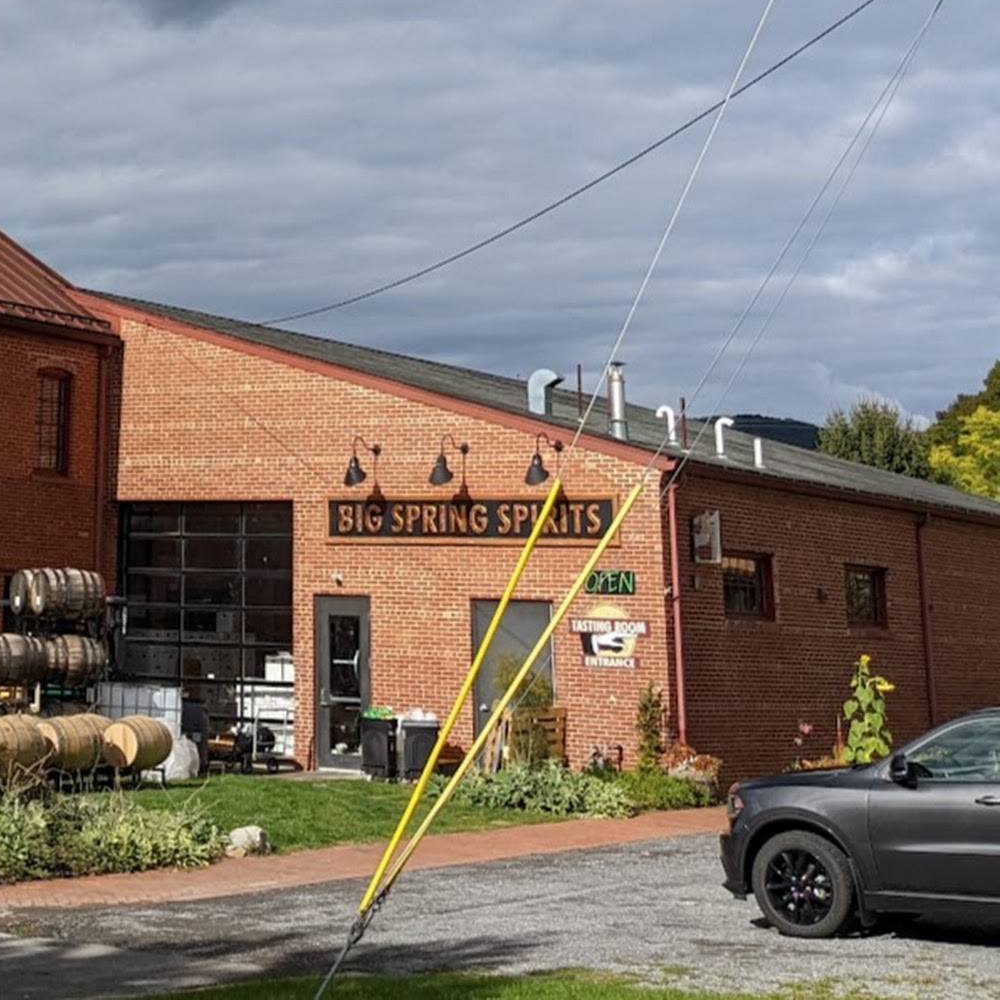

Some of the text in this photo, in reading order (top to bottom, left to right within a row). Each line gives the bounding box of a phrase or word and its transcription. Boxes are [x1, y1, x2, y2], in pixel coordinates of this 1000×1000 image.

[338, 504, 383, 532] BIG
[391, 504, 488, 533] SPRING
[584, 571, 634, 593] OPEN
[571, 619, 646, 634] TASTING ROOM
[584, 657, 636, 668] ENTRANCE
